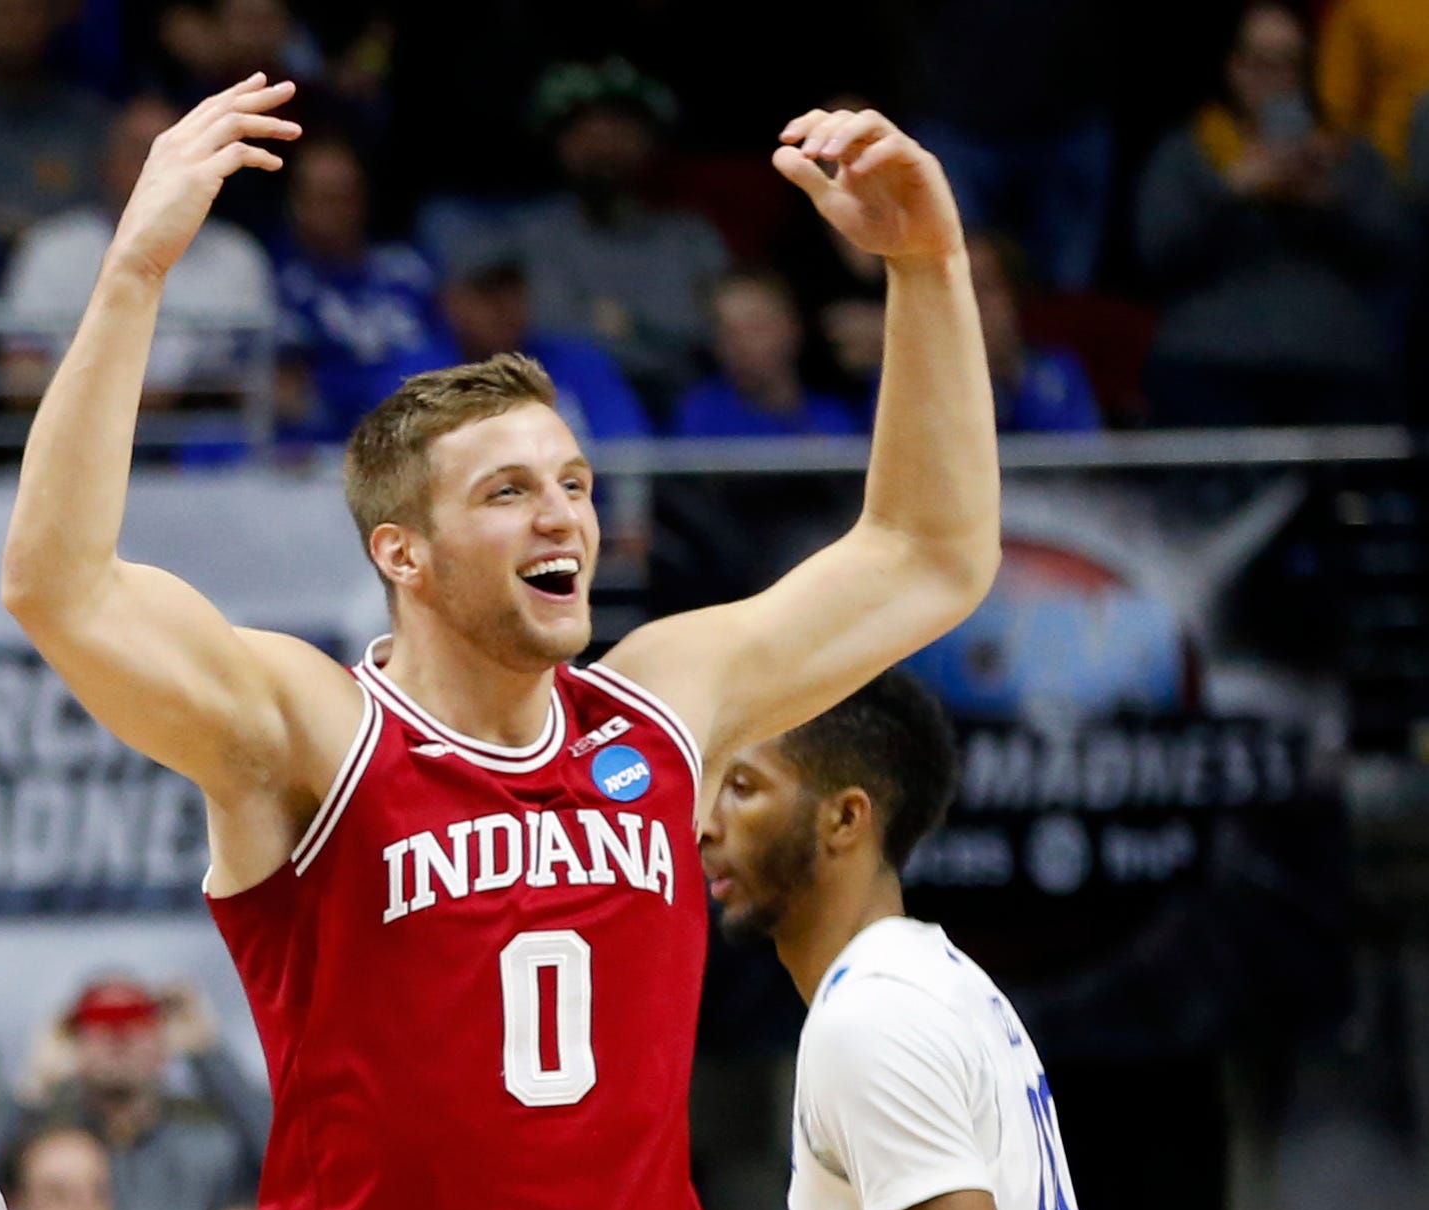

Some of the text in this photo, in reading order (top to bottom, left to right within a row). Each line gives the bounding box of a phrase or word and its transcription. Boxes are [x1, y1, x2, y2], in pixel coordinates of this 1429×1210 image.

[604, 761, 650, 794] NCAA
[382, 809, 675, 925] INDIANA
[499, 929, 598, 1108] 0
